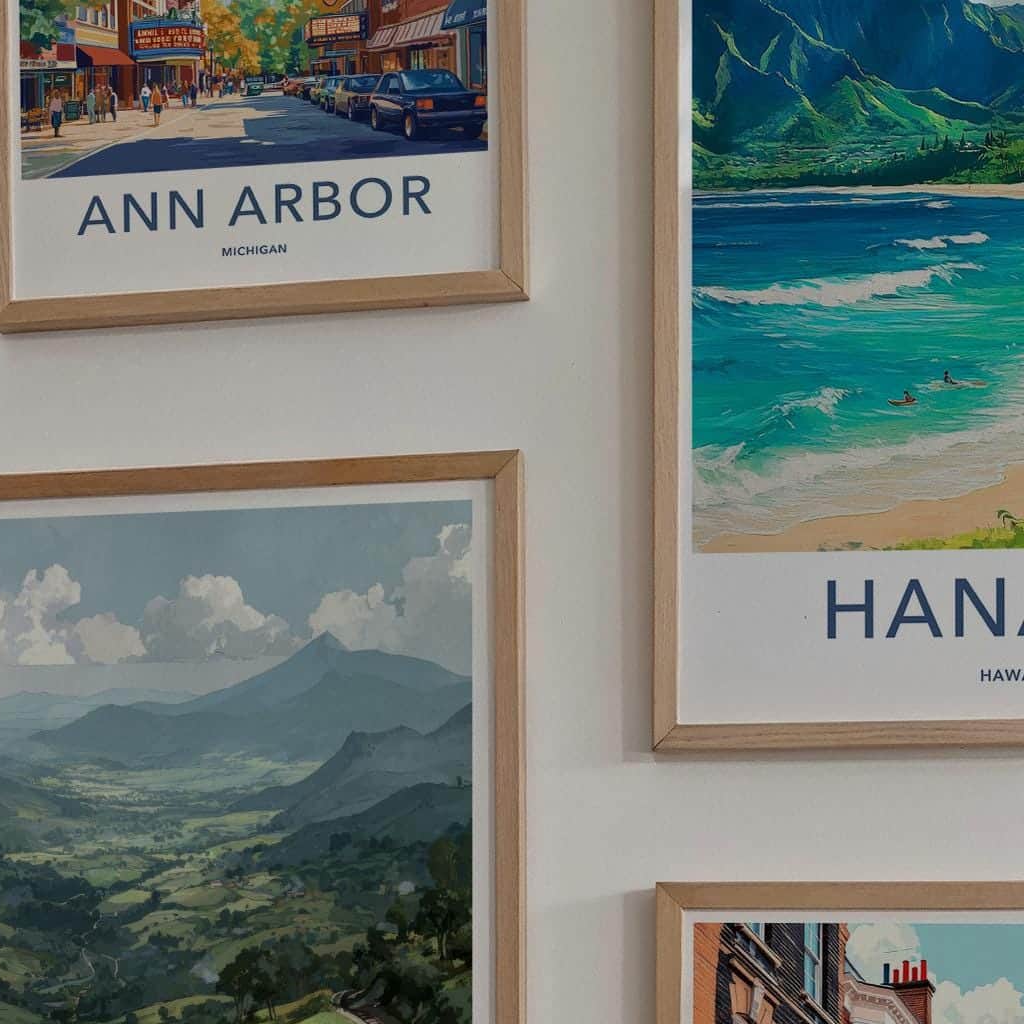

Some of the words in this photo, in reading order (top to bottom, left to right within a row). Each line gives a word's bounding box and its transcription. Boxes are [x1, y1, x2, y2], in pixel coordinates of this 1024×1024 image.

[77, 188, 205, 236] ANN
[228, 174, 432, 227] ARBOR
[221, 243, 288, 257] MICHIGAN
[826, 577, 1024, 640] HAN
[980, 668, 1024, 683] HAW
